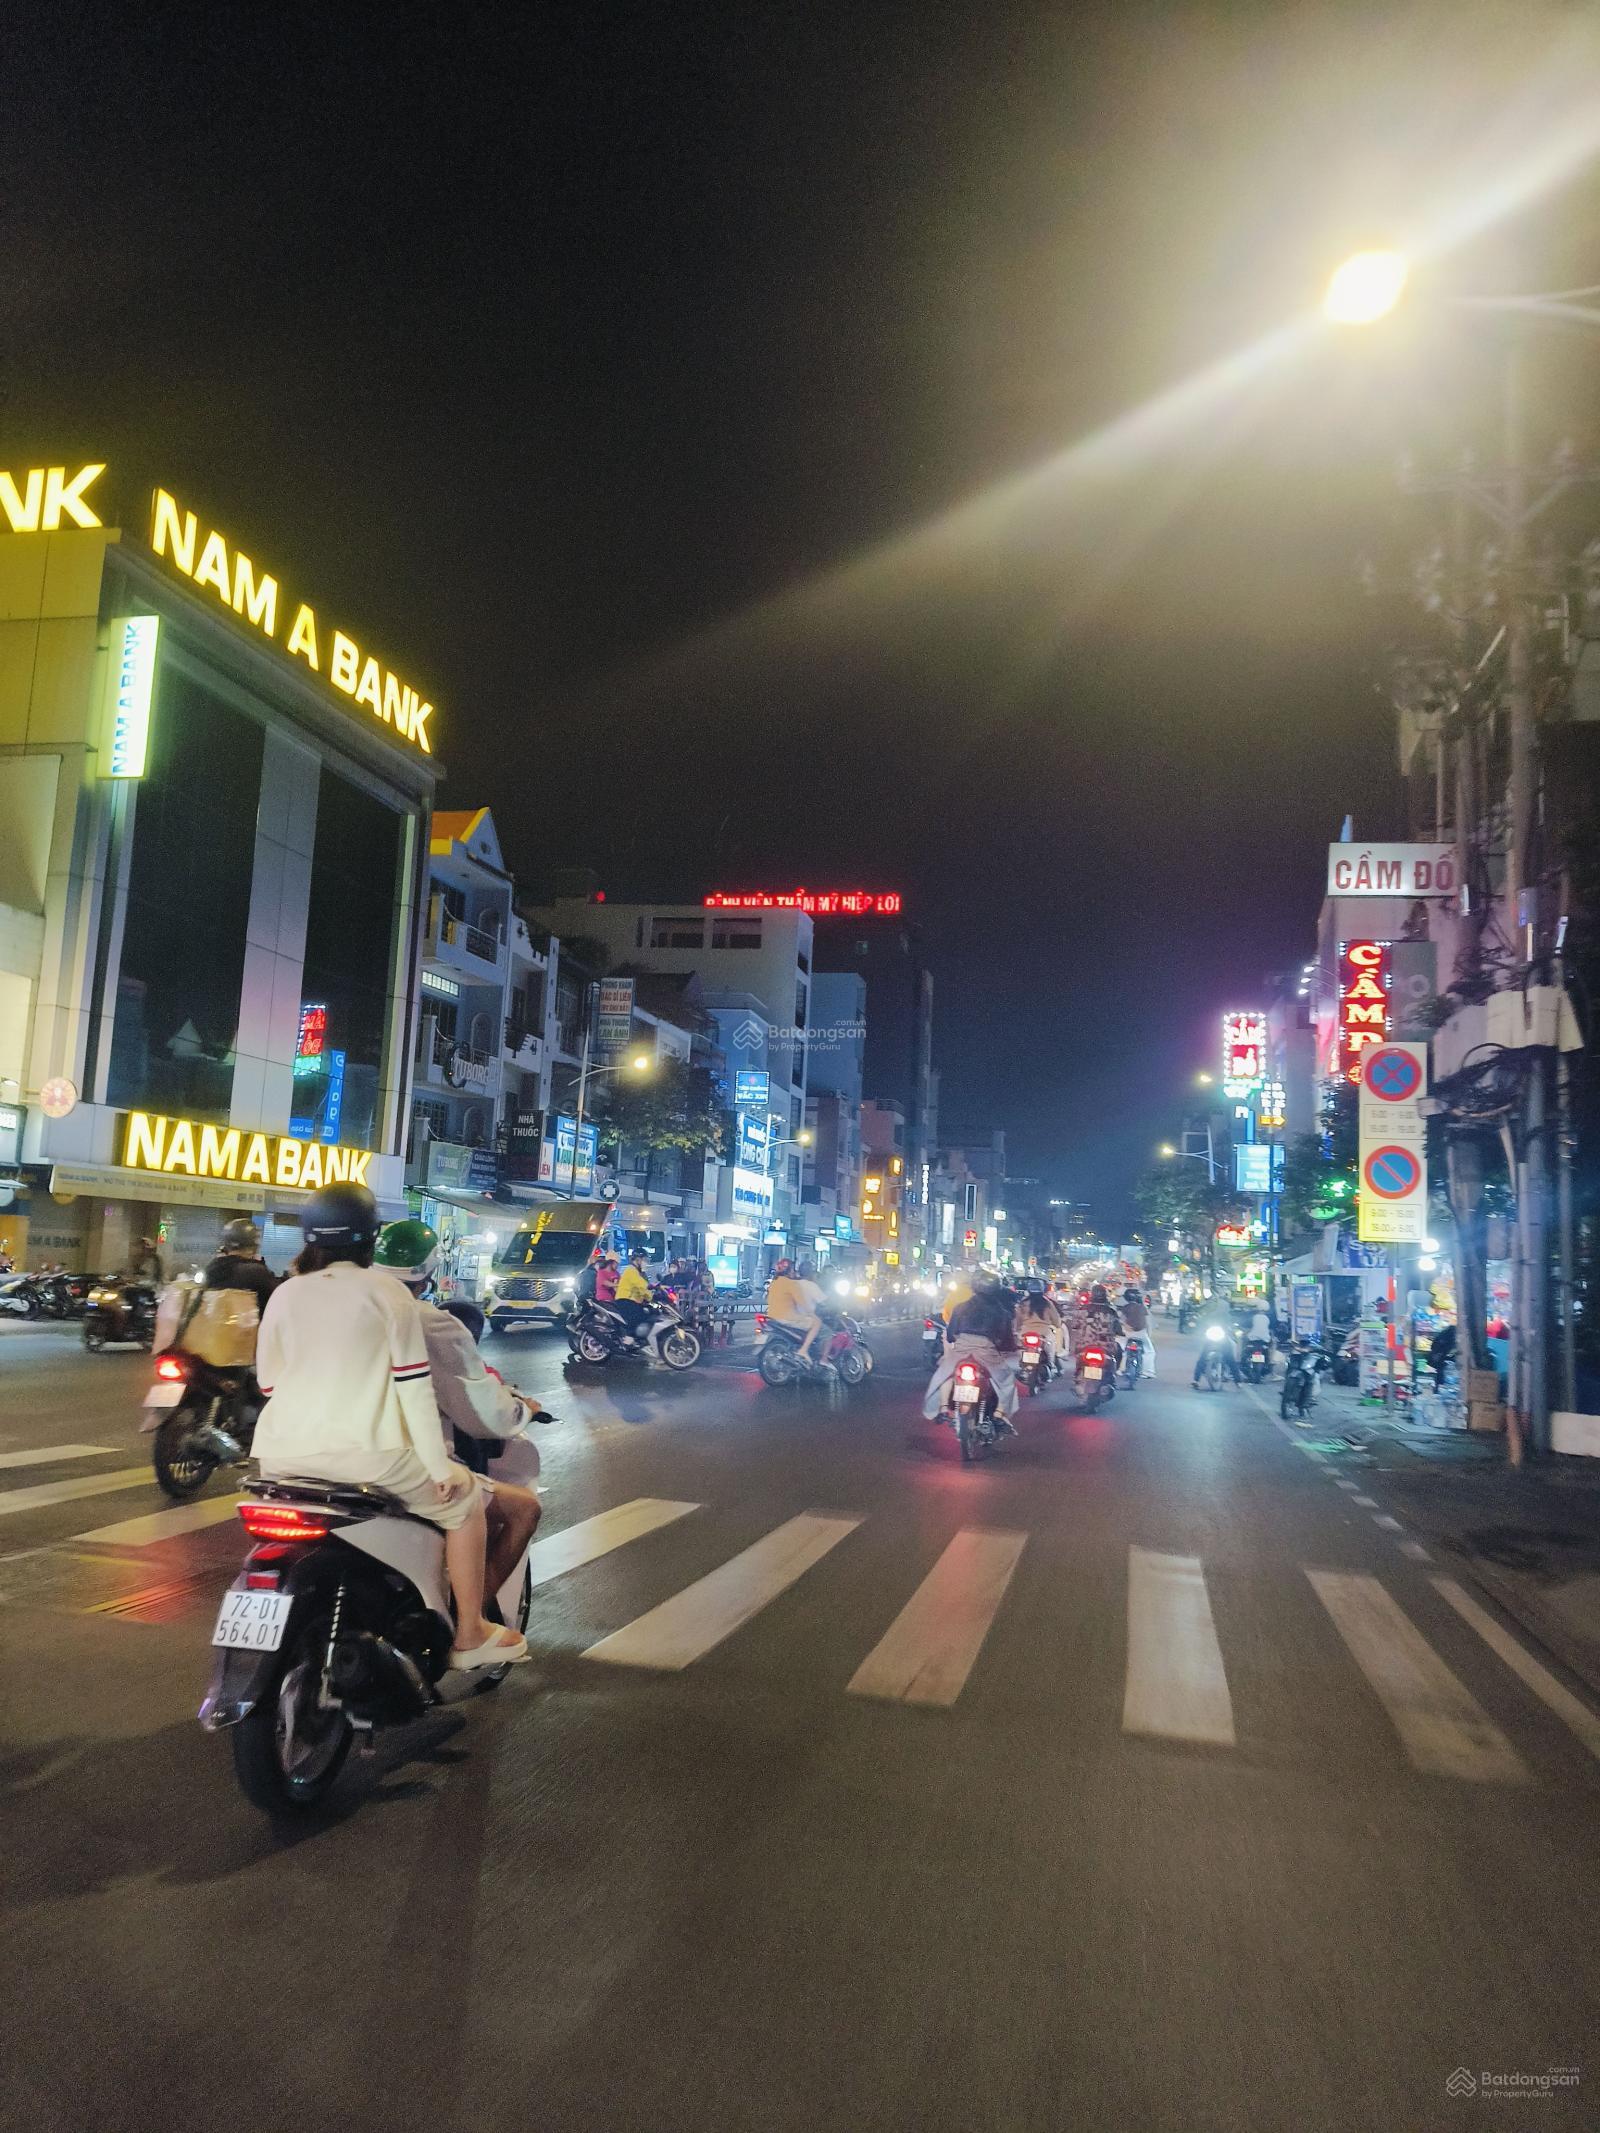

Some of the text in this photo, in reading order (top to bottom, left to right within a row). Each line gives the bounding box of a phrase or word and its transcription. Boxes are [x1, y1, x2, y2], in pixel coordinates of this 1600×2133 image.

[151, 487, 434, 754] NAM A BANK
[120, 623, 143, 689] BANK
[111, 717, 130, 775] NAM
[1335, 850, 1403, 891] CẦM
[512, 1125, 540, 1137] THUỐC
[518, 1113, 535, 1124] NHÀ
[126, 1111, 372, 1189] NAM A BANK
[217, 1619, 280, 1647] 564.01
